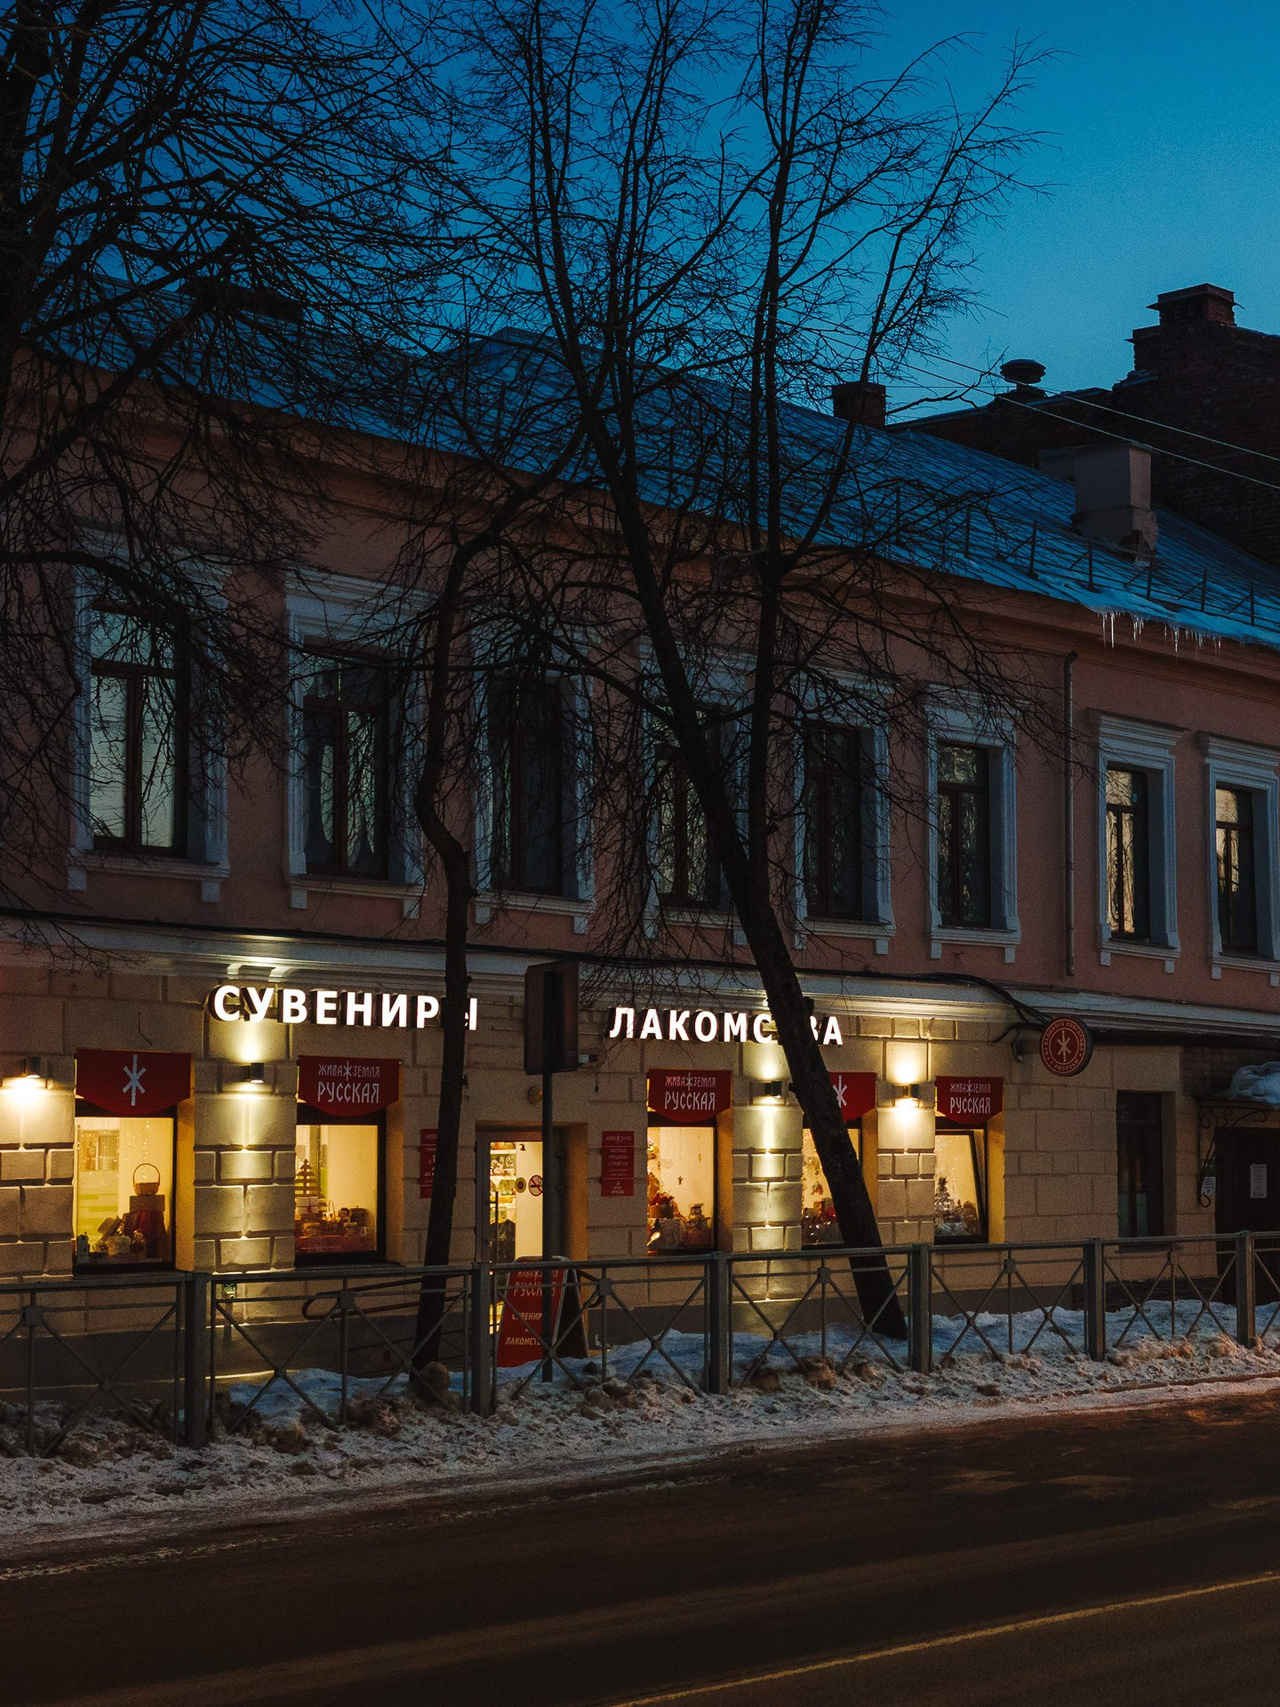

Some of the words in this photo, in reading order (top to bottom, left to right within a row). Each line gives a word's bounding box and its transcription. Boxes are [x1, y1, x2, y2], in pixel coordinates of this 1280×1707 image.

[609, 1007, 843, 1046] ЛАКОМСА
[317, 1082, 380, 1103] РУССКАЯ
[664, 1091, 716, 1111] РУССКАЯ
[950, 1096, 991, 1114] РУССКАЯ
